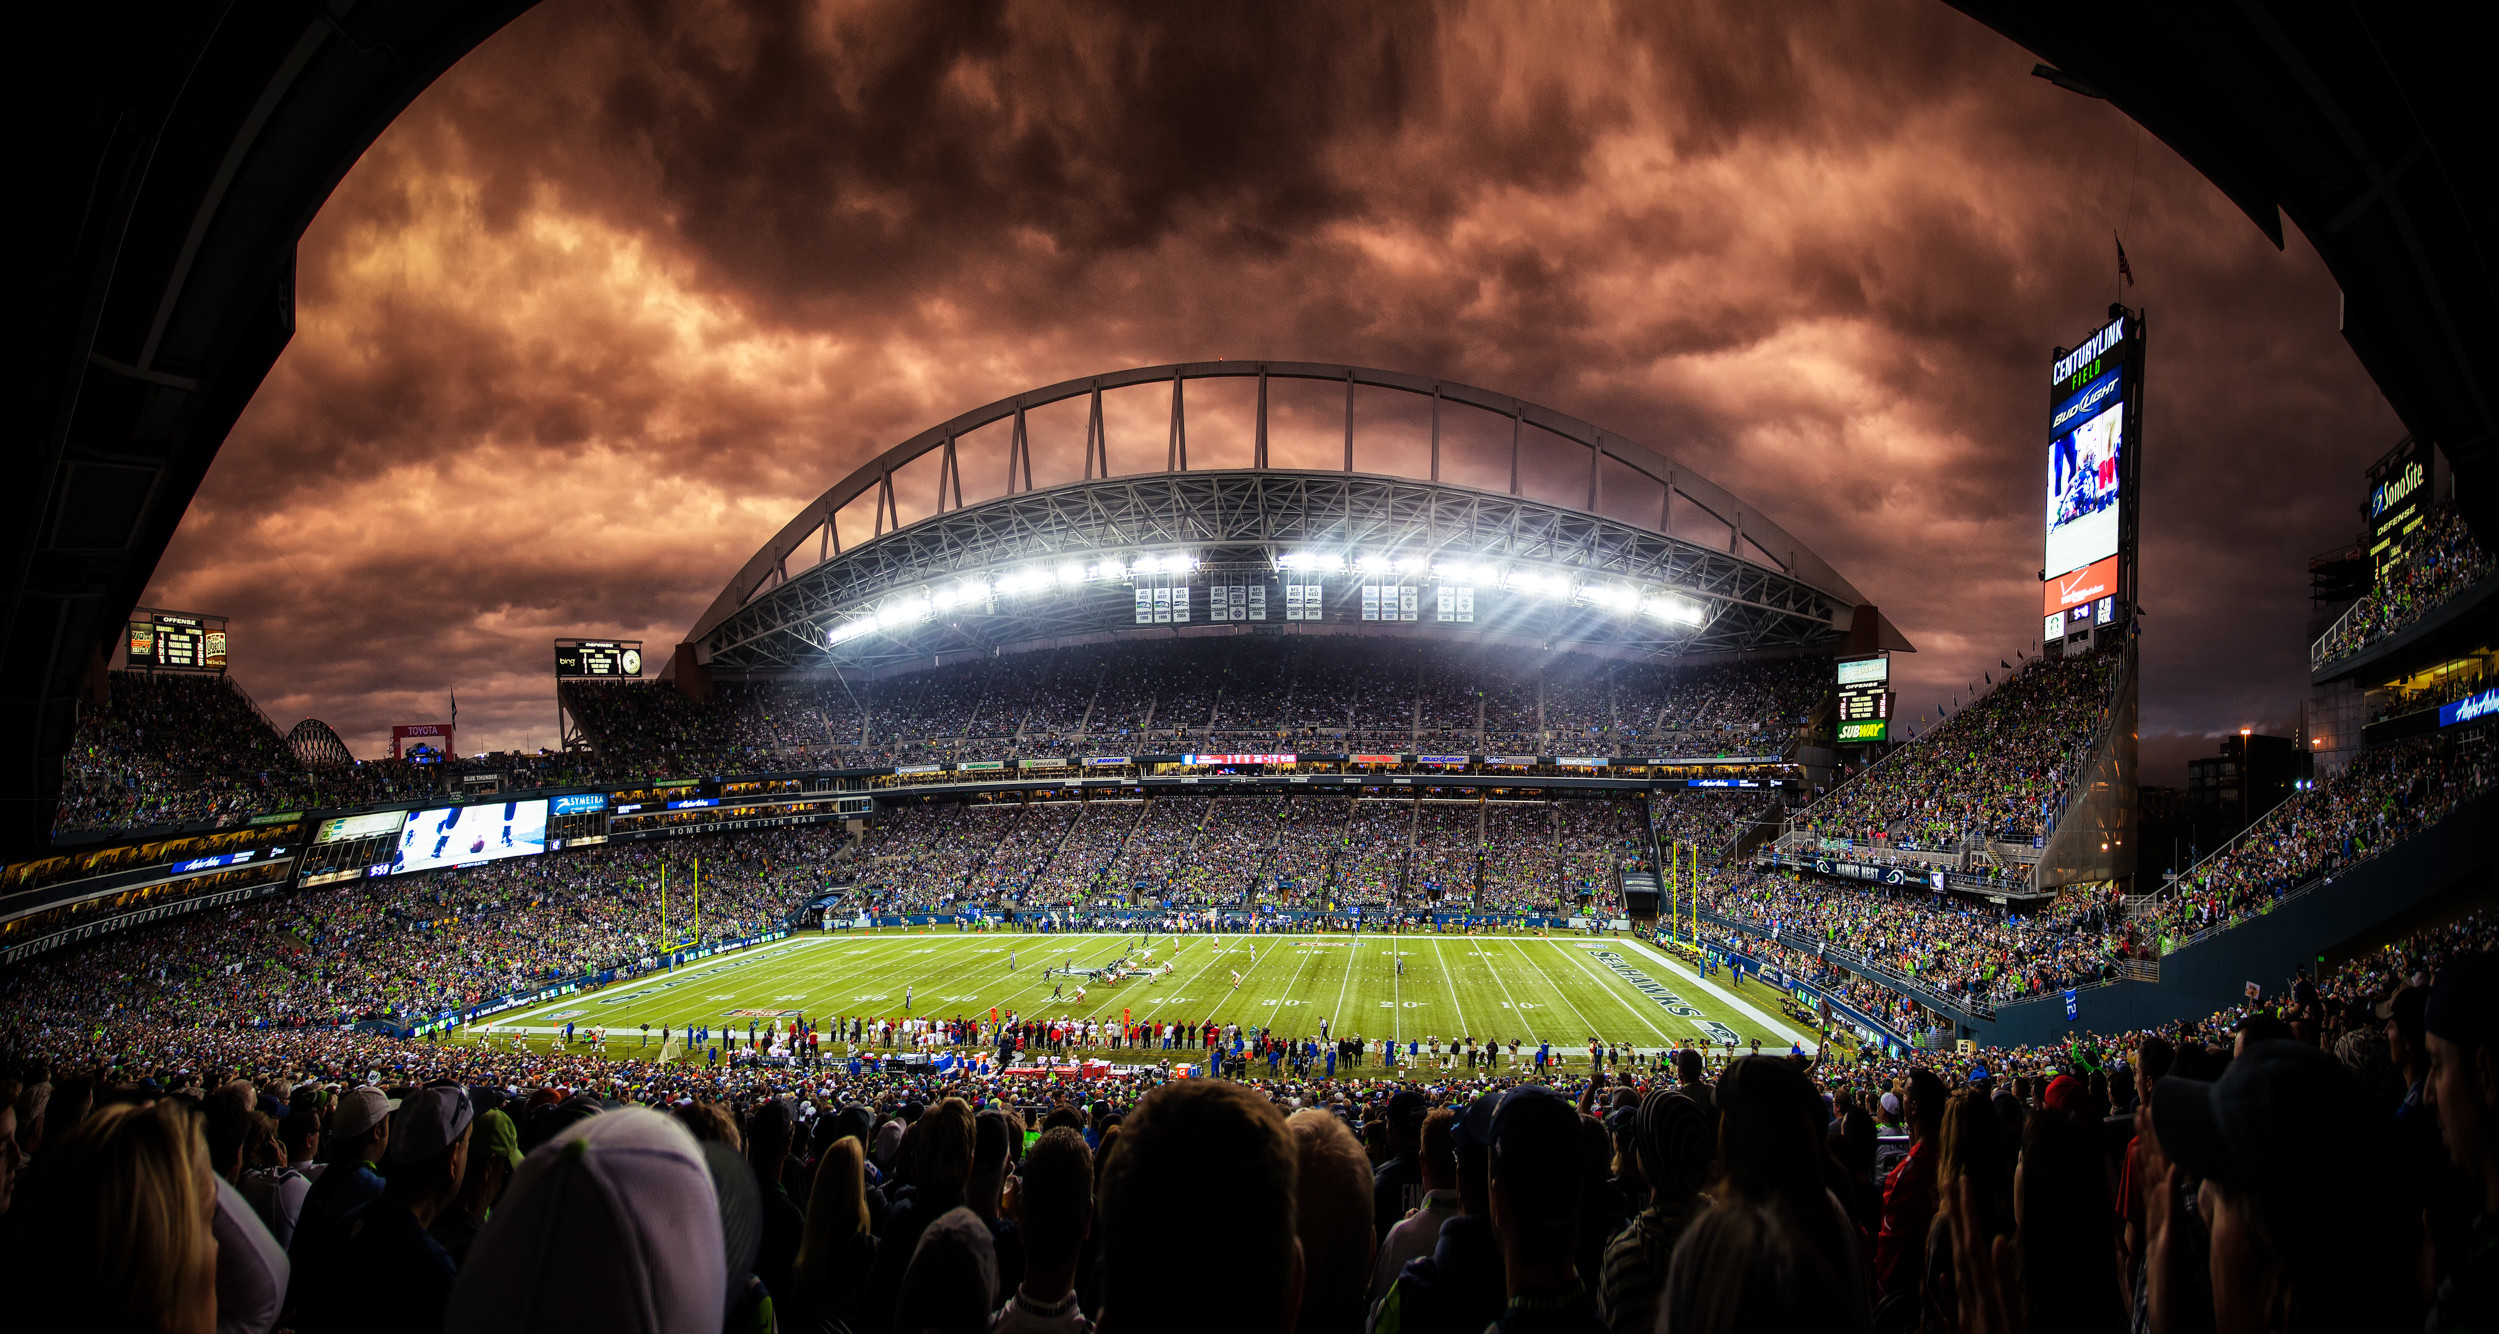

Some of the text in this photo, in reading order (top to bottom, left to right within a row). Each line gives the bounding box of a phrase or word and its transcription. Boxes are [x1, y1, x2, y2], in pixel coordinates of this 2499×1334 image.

[2053, 316, 2124, 386] CENTURYLINK
[2072, 359, 2101, 391] FIELD
[2053, 377, 2119, 428] BUD LIGHT
[2383, 461, 2424, 511] SonoSite
[2377, 503, 2417, 537] DEFENSE
[2403, 514, 2424, 536] VISITORS
[163, 617, 197, 625] OFFENSE
[560, 658, 576, 667] bing
[408, 726, 438, 735] TOYOTA
[1839, 723, 1884, 739] SUBWAY
[570, 795, 604, 806] SYMETRA
[670, 826, 701, 836] HOME
[728, 821, 749, 830] THE
[757, 818, 784, 827] 12TH
[792, 816, 816, 824] MAN
[1836, 863, 1880, 880] HAWKS NEST
[6, 889, 253, 965] WELCOME TO CENTURYLINK FIELD
[1586, 950, 1706, 1017] SEAHAWKS
[1501, 1001, 1534, 1009] 10
[2066, 995, 2077, 1015] 12
